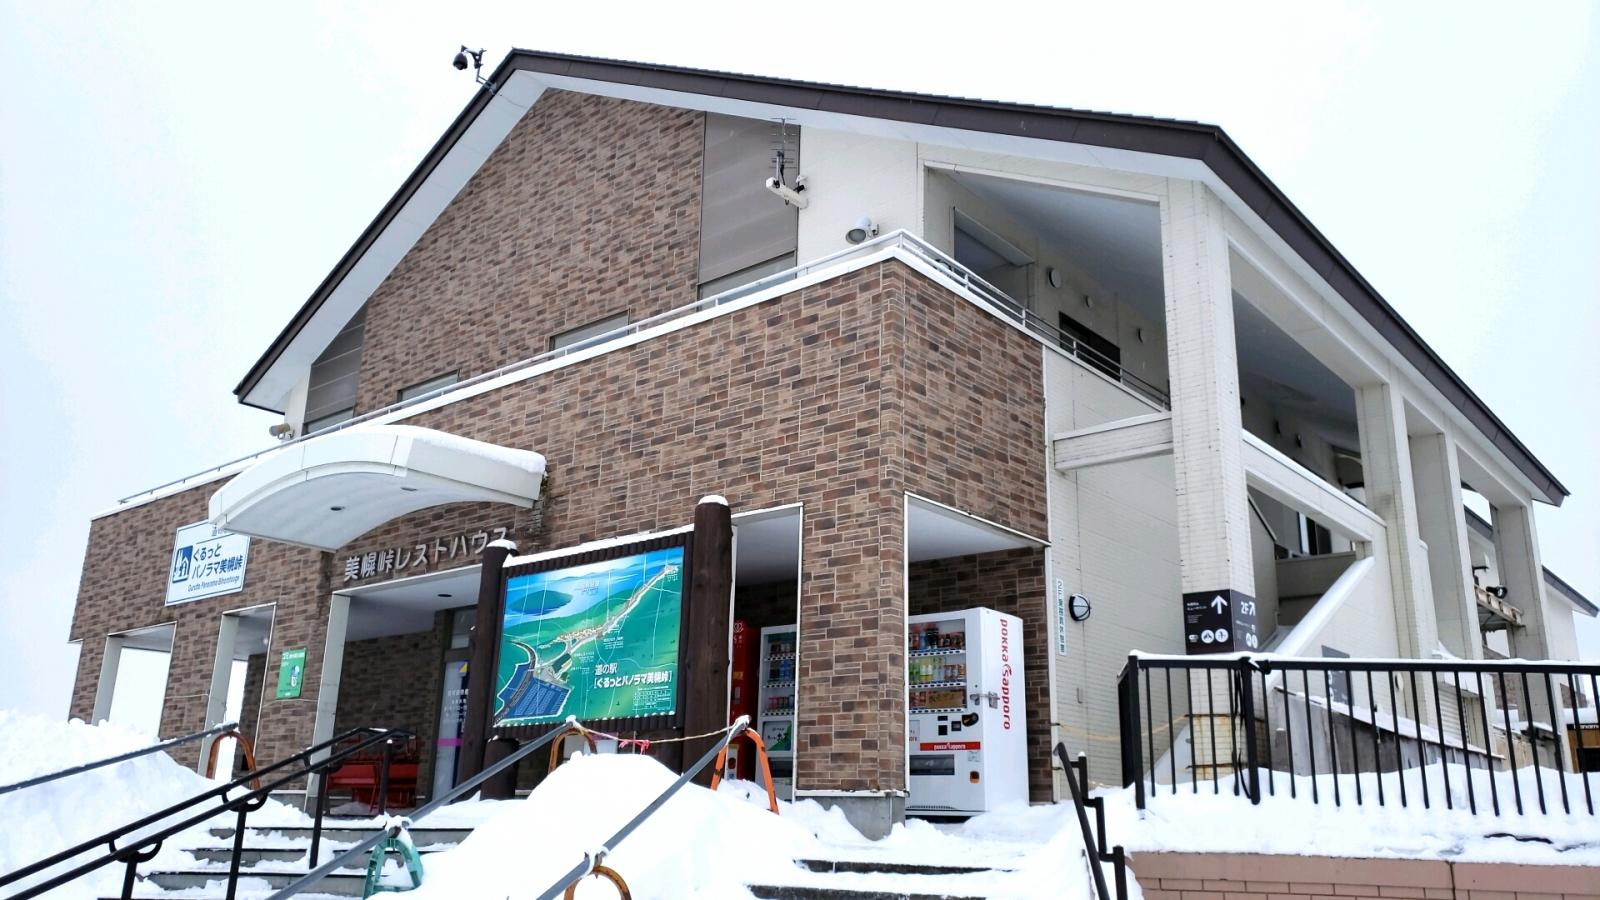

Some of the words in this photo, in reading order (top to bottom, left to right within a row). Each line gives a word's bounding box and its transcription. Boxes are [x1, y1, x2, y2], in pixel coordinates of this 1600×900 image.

[1241, 600, 1250, 615] 2F
[595, 662, 618, 676] 道の駅
